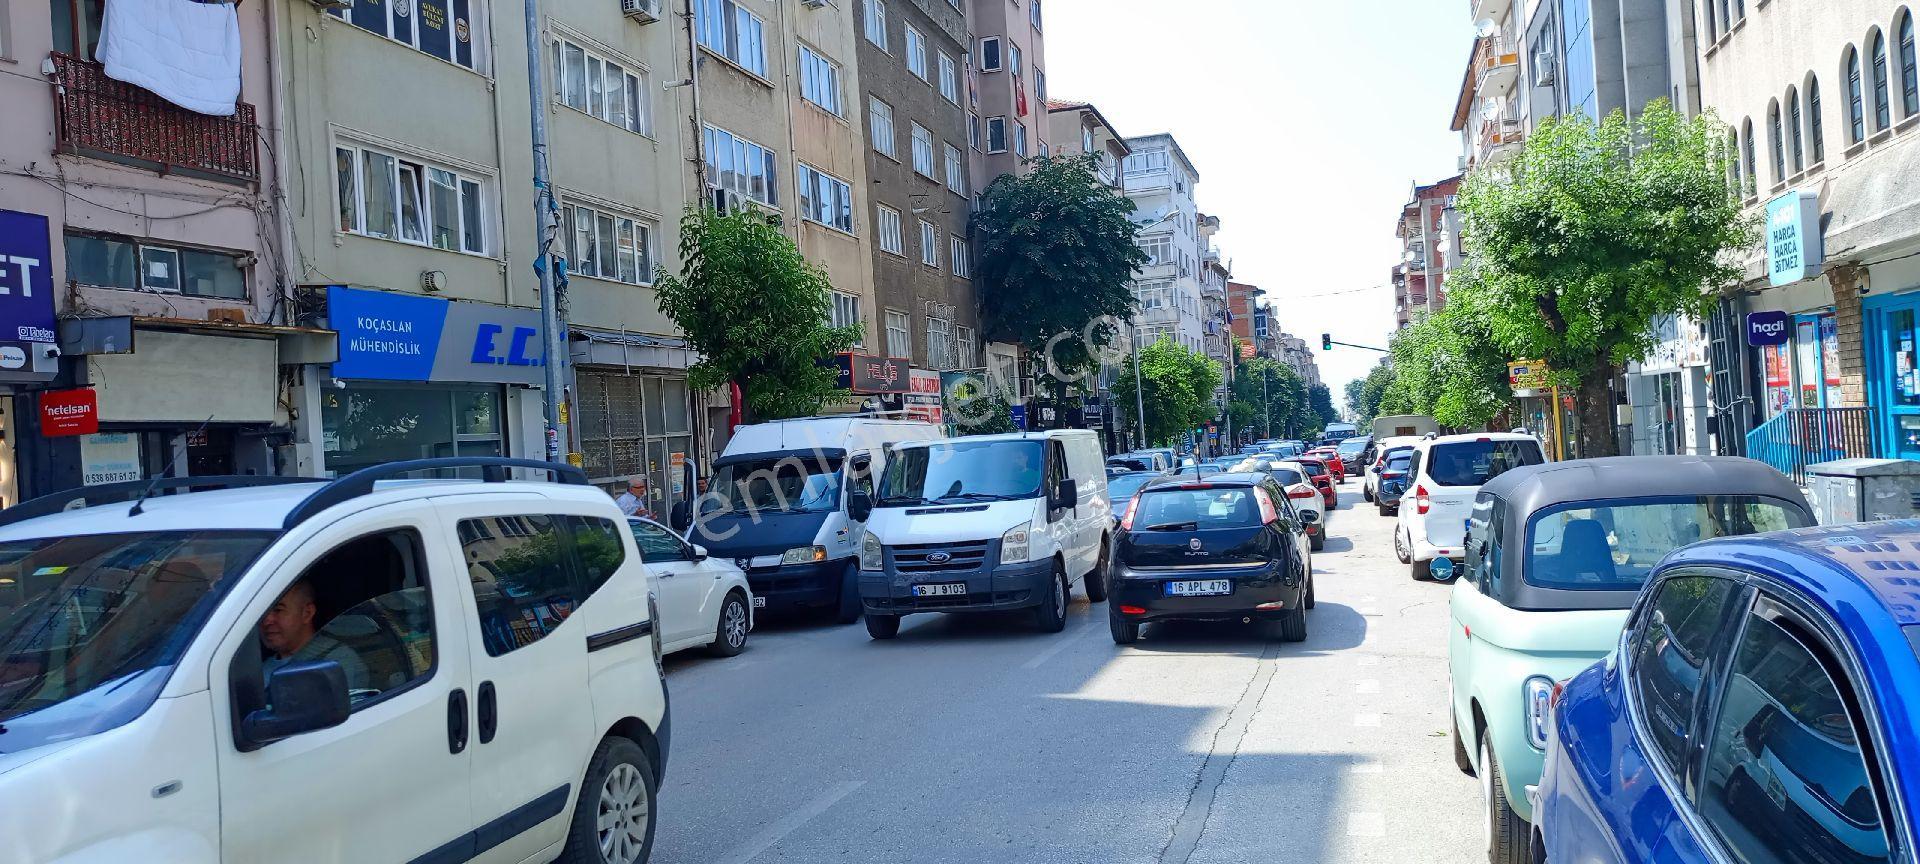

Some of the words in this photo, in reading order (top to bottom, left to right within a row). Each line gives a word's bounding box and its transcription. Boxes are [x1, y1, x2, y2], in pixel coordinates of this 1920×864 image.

[1773, 224, 1796, 244] HARCA
[1774, 240, 1798, 259] HARCA
[357, 316, 412, 334] KOÇASLAN
[1752, 320, 1785, 336] hadi
[350, 337, 421, 355] MÜHENDİSLİK
[128, 471, 137, 480] 37
[917, 586, 927, 595] 16
[931, 586, 937, 595] J
[941, 584, 965, 595] 9103
[1174, 583, 1184, 592] 16
[1188, 582, 1206, 592] APL
[1210, 581, 1228, 591] 478
